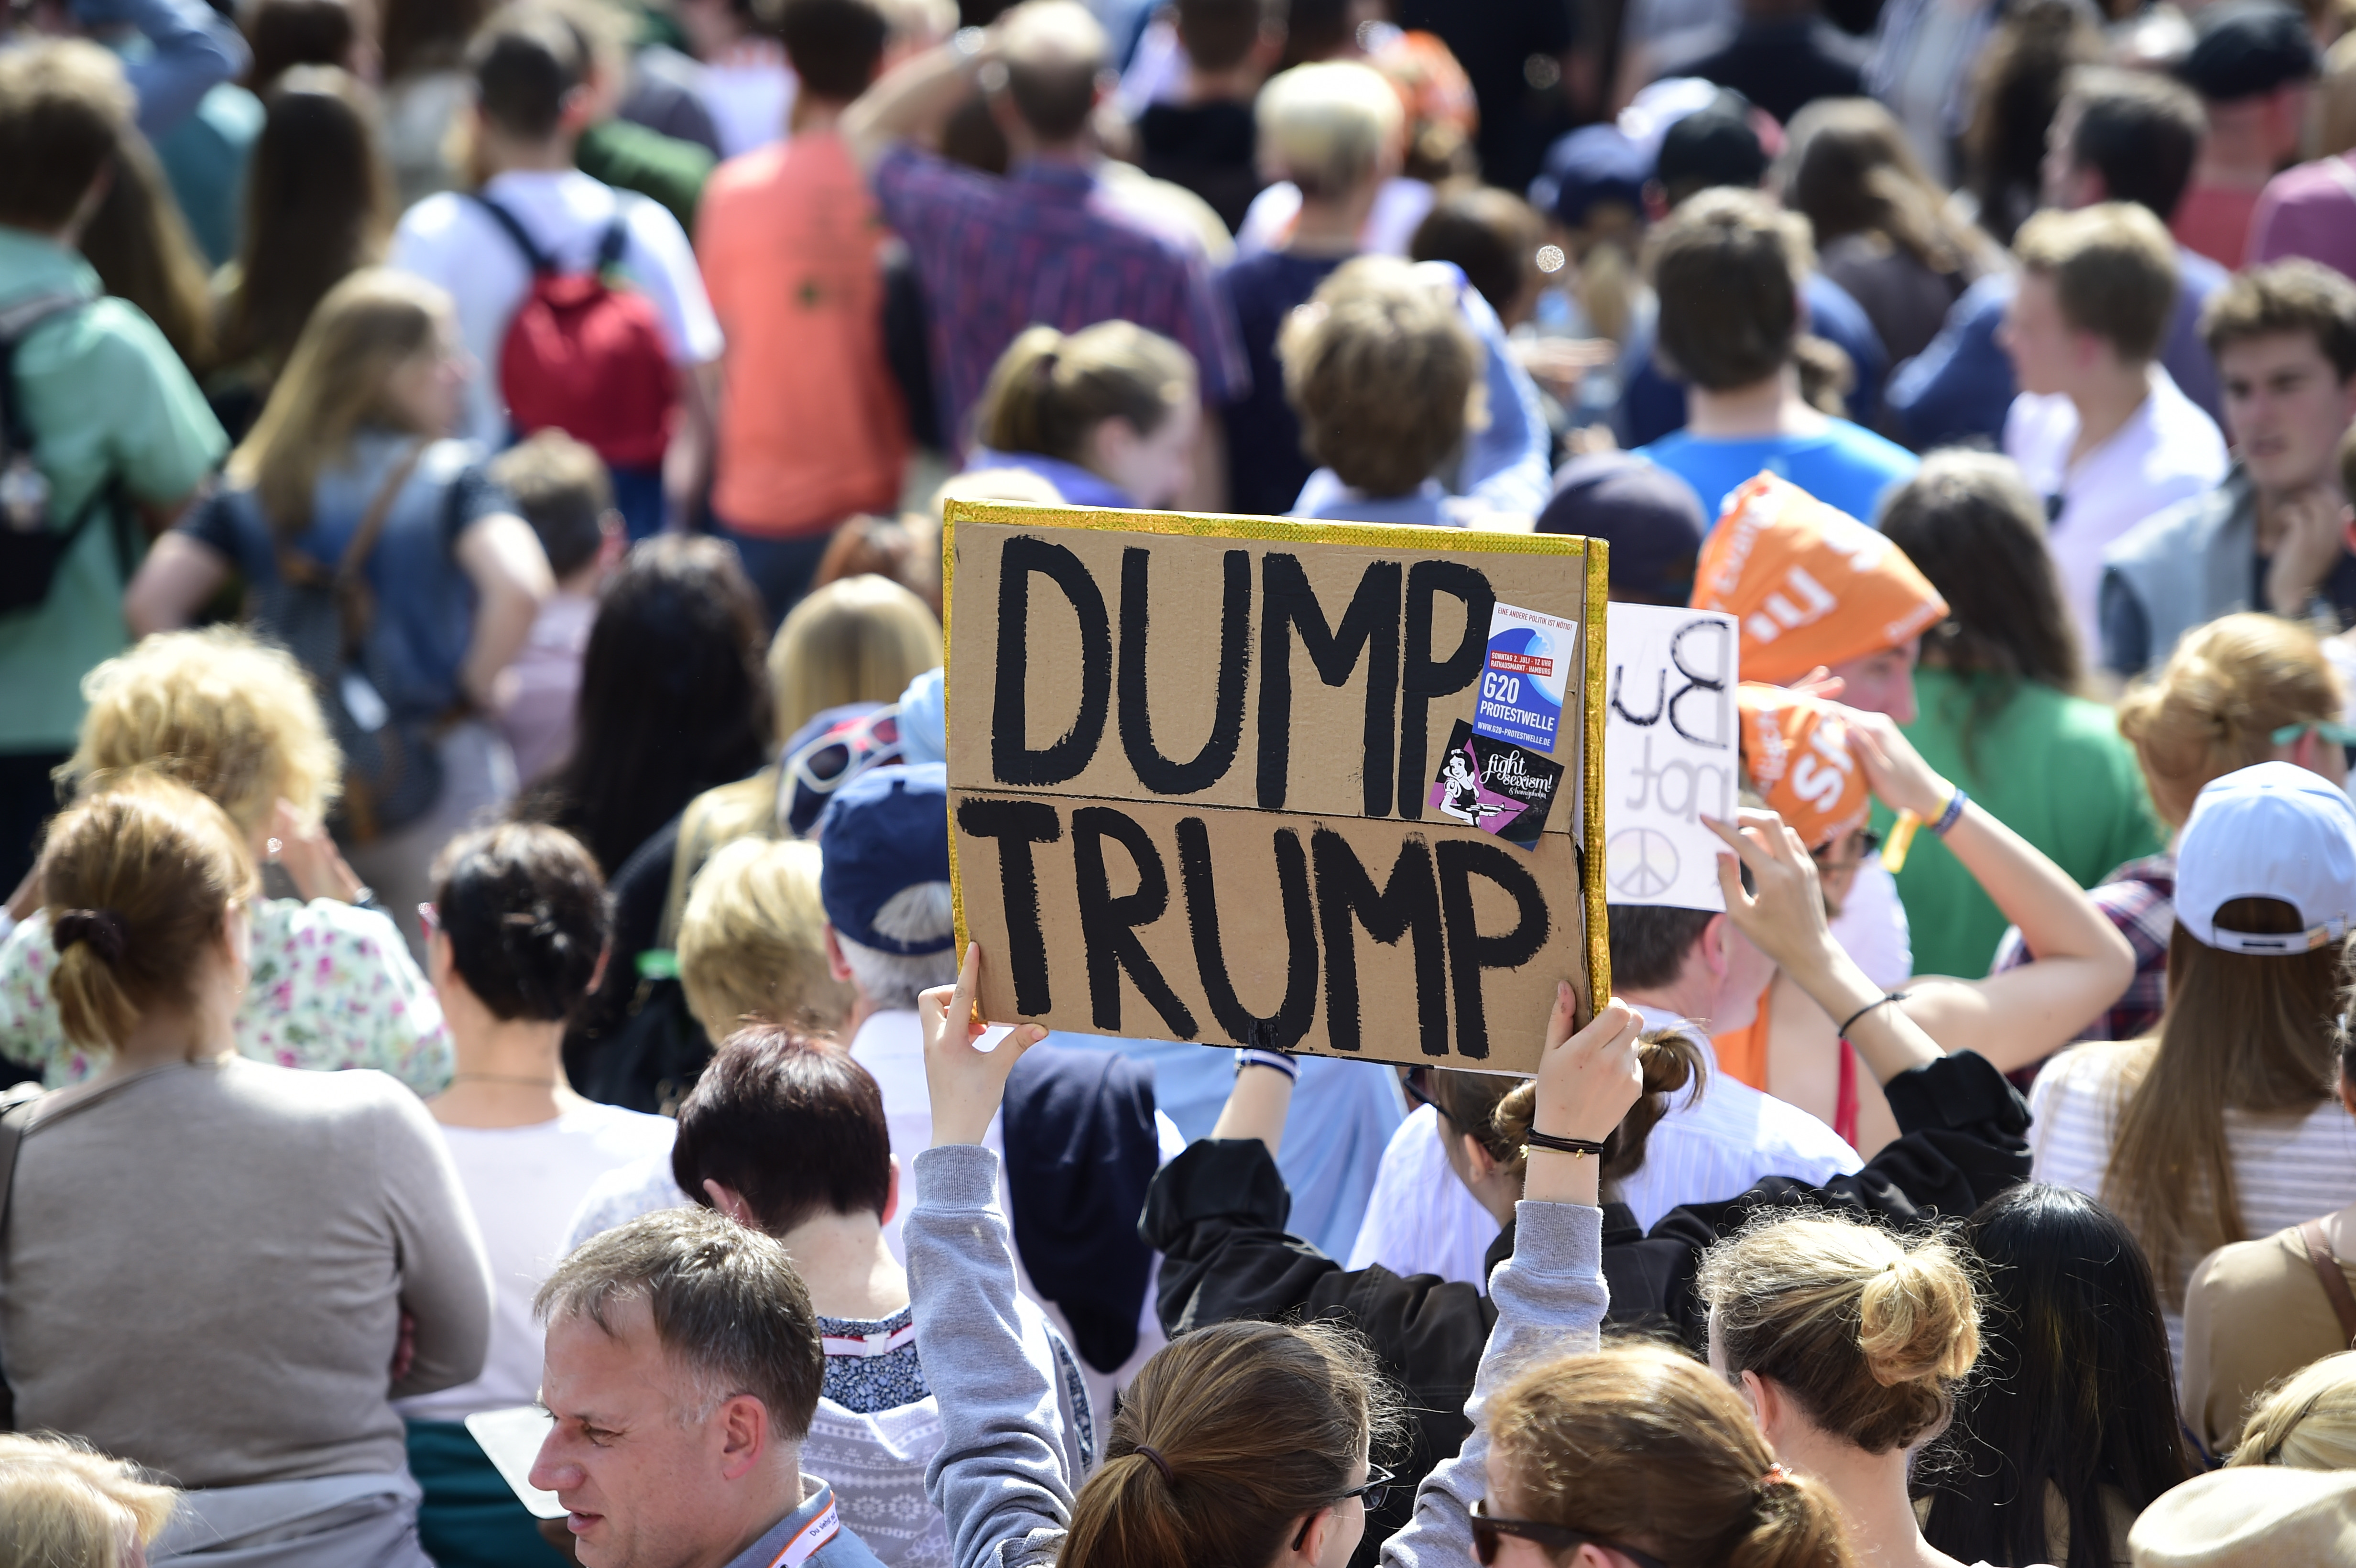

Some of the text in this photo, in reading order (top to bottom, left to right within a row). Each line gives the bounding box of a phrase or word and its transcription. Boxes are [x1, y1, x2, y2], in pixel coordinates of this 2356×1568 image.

[1497, 607, 1509, 616] EINE
[1509, 610, 1528, 621] ANDERE
[1529, 614, 1547, 624] POLITIK
[1556, 621, 1573, 631] NÖTIG!
[1491, 652, 1513, 662] SONNTAG
[1491, 660, 1551, 675] RATHAUSMARKT HAMBURG
[991, 534, 1497, 820] DUMP
[1483, 672, 1520, 704] G20
[1480, 700, 1555, 731] PROTESTWELLE
[1477, 721, 1551, 746] WWW.G20-PROTESTWELLE.DE
[1478, 750, 1527, 784] fight
[1503, 774, 1553, 793] sexism!
[957, 796, 1551, 1060] TRUMP
[809, 1528, 820, 1536] Du
